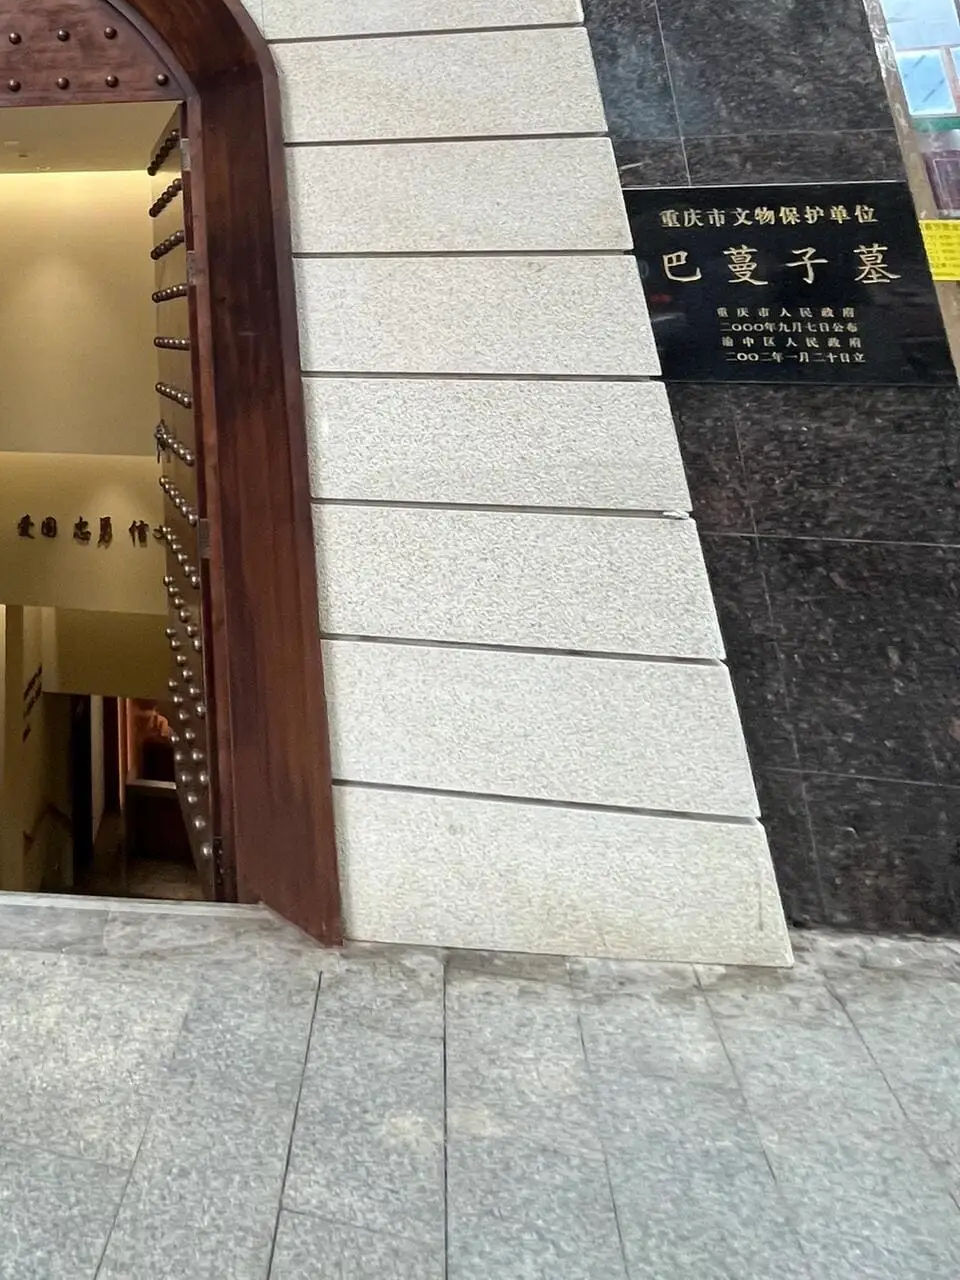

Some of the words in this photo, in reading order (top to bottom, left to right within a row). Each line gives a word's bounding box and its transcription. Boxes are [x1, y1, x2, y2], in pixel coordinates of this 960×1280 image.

[658, 204, 879, 228] 重庆市文物保护单位
[661, 243, 902, 285] 巴蔓子墓
[716, 306, 855, 319] 重庆市人民政府
[721, 336, 862, 349] 渝中区人民政府
